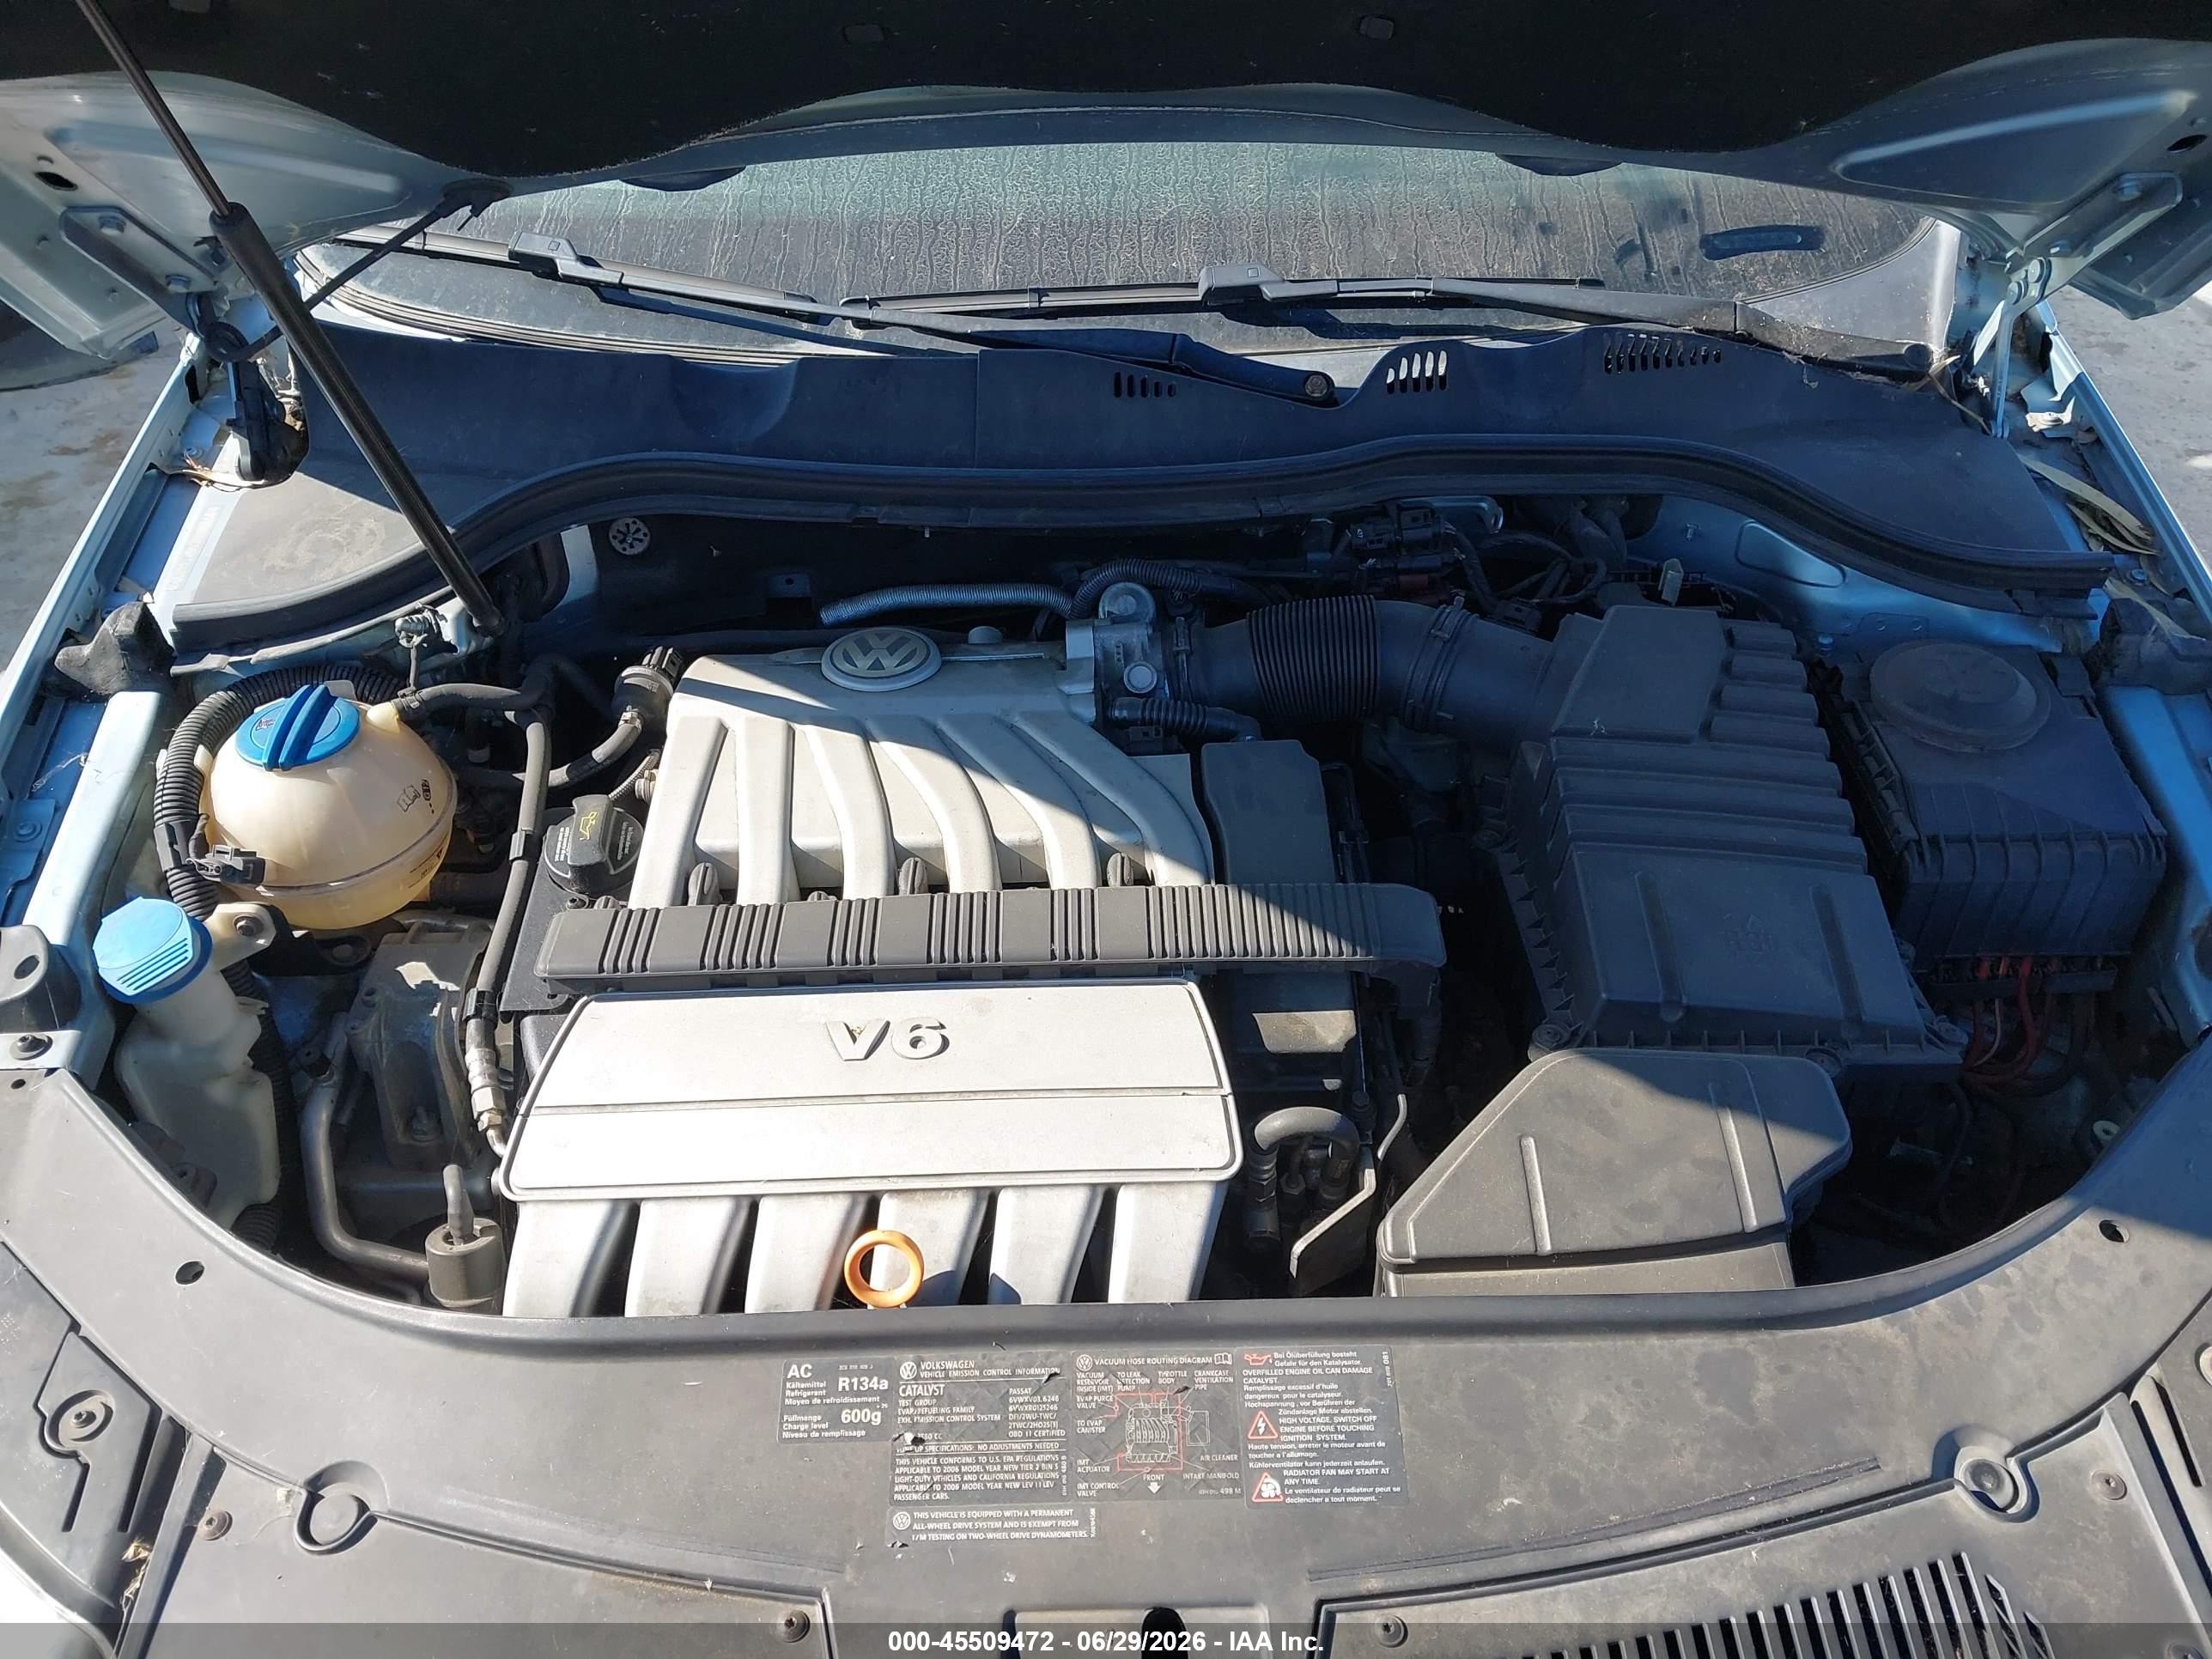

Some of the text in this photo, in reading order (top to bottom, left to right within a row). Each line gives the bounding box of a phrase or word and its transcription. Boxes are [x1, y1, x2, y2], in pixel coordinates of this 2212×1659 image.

[825, 1018, 950, 1061] V6
[787, 1364, 812, 1378] AC
[921, 1360, 975, 1370] VOLKSWAGEN
[838, 1377, 888, 1391] R134a
[899, 1384, 945, 1397] CATALYST
[842, 1409, 881, 1425] 600g
[1030, 1509, 1073, 1517] PERMANENT
